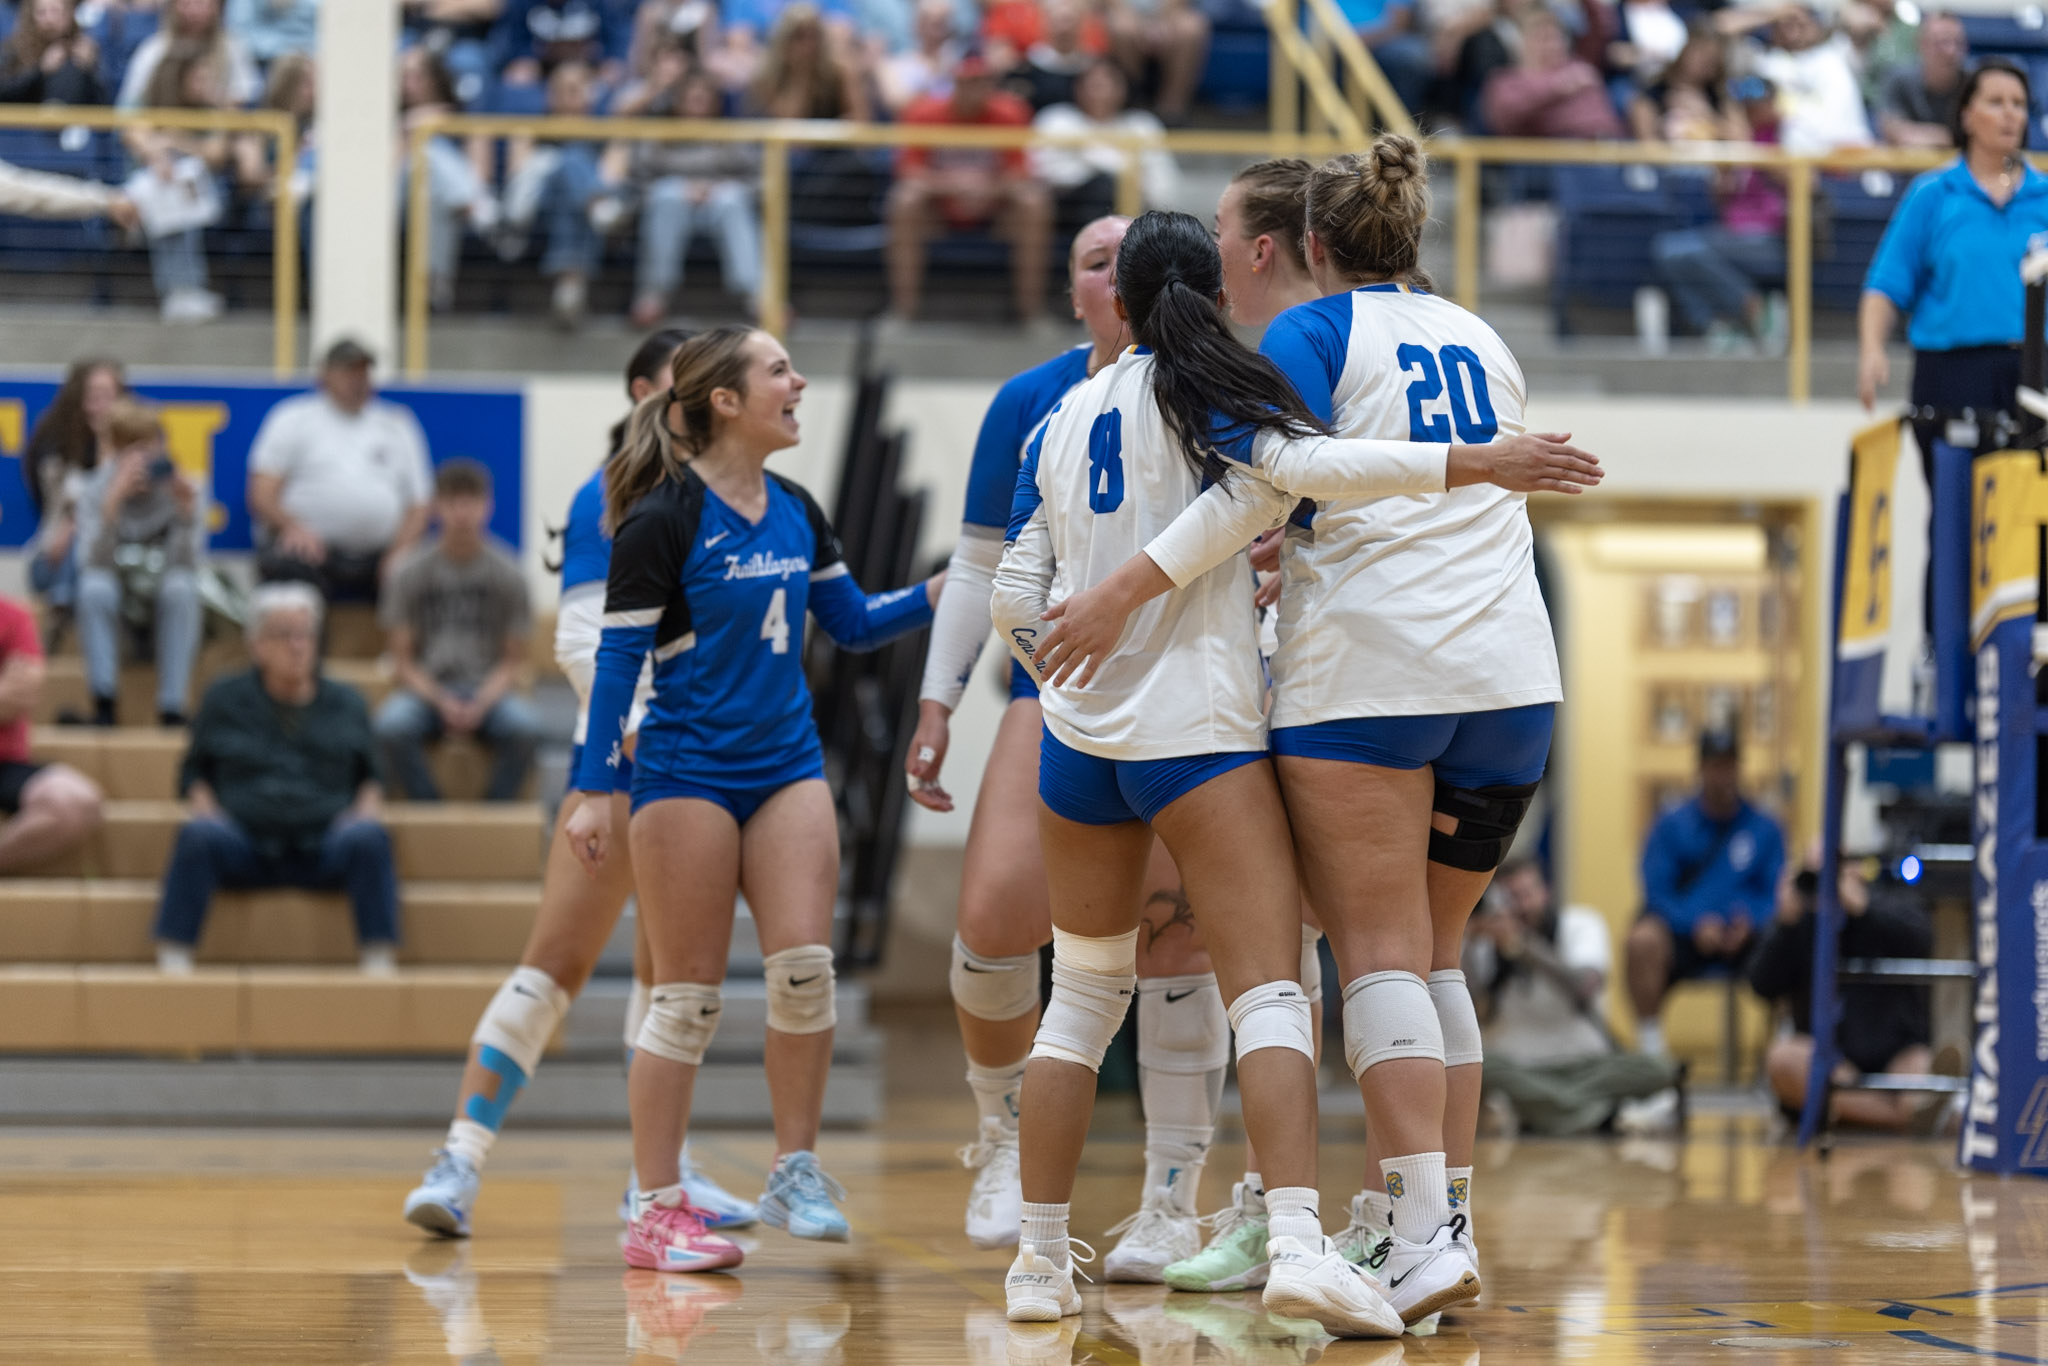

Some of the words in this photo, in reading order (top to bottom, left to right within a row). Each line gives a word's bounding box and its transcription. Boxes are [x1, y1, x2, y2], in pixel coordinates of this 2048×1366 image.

[1396, 342, 1498, 445] 20
[1088, 407, 1125, 515] 8
[760, 587, 790, 655] 4
[1961, 642, 2000, 1167] TRAILBLAZERS
[1009, 1274, 1053, 1285] RIP-IT
